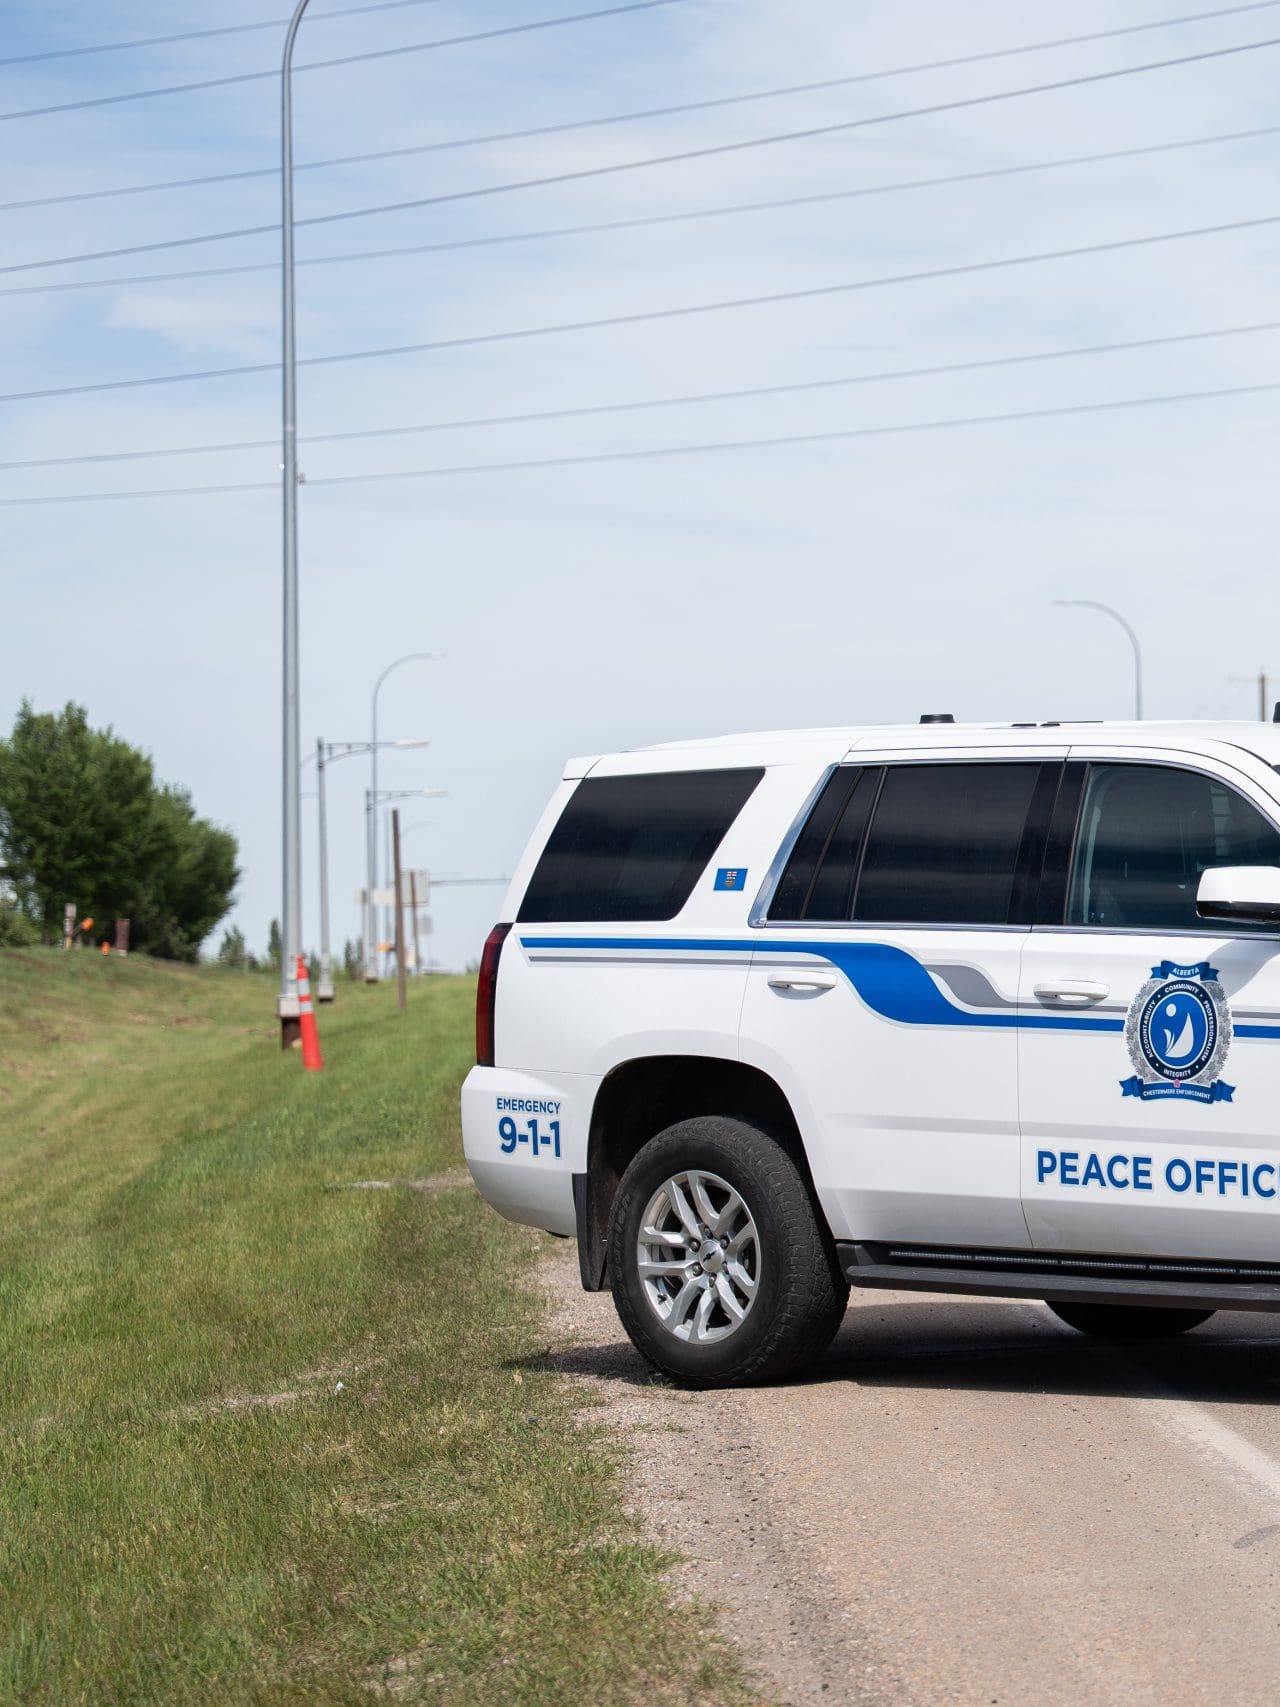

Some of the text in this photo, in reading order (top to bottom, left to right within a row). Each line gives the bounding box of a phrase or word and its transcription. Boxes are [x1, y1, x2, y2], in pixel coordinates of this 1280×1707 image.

[1172, 967, 1200, 976] ALBERTA
[1164, 983, 1199, 994] COMMUNITY
[1142, 1000, 1157, 1059] ACCOUNTABILITY
[1201, 1000, 1214, 1062] PROFESSIONALISM
[1163, 1068, 1191, 1078] INTEGRITY
[1143, 1088, 1211, 1099] CHESTERMERE ENFORCEMENT
[497, 1098, 561, 1114] EMERGENCY
[499, 1116, 561, 1158] 9-1-1
[1037, 1151, 1153, 1192] PEACE
